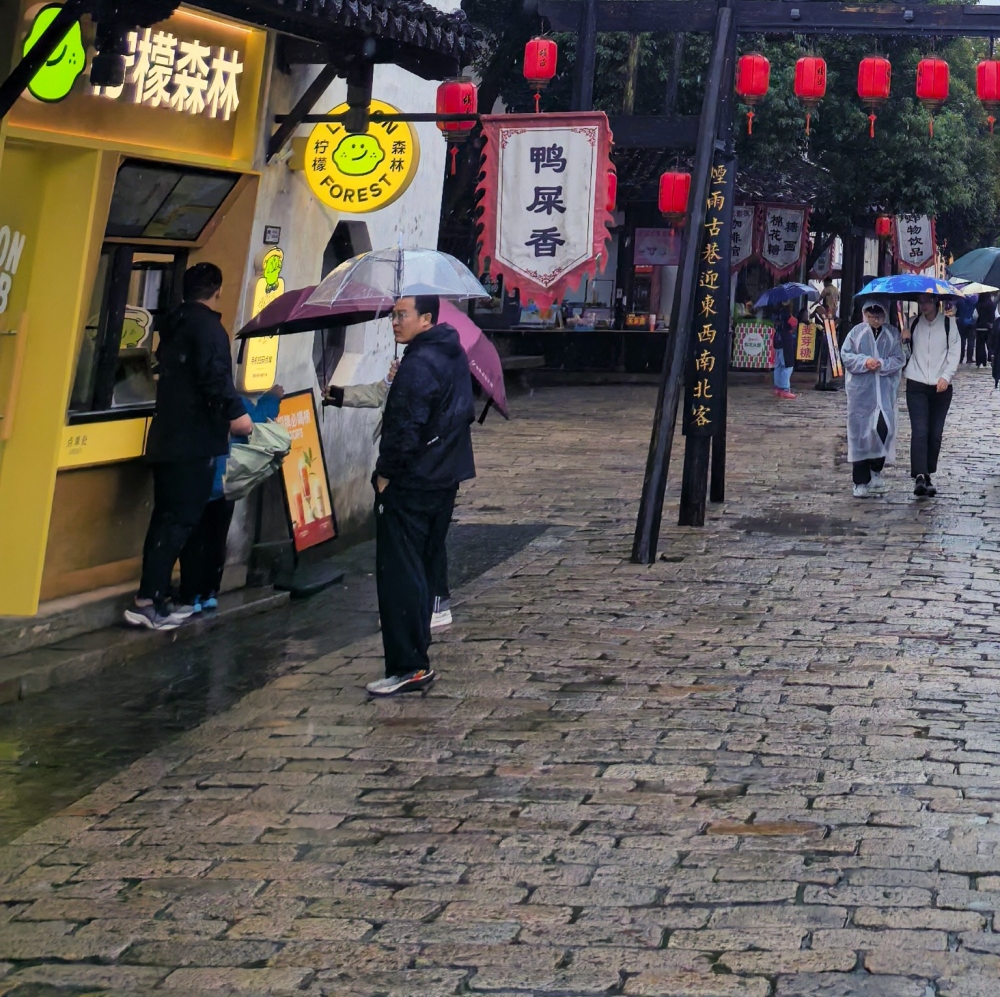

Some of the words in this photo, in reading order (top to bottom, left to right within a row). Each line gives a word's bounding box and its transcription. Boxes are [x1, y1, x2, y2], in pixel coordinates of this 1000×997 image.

[92, 27, 243, 121] 檬森林
[389, 140, 406, 172] 森林
[319, 172, 392, 204] FOREST
[524, 142, 568, 258] 鸭屎香
